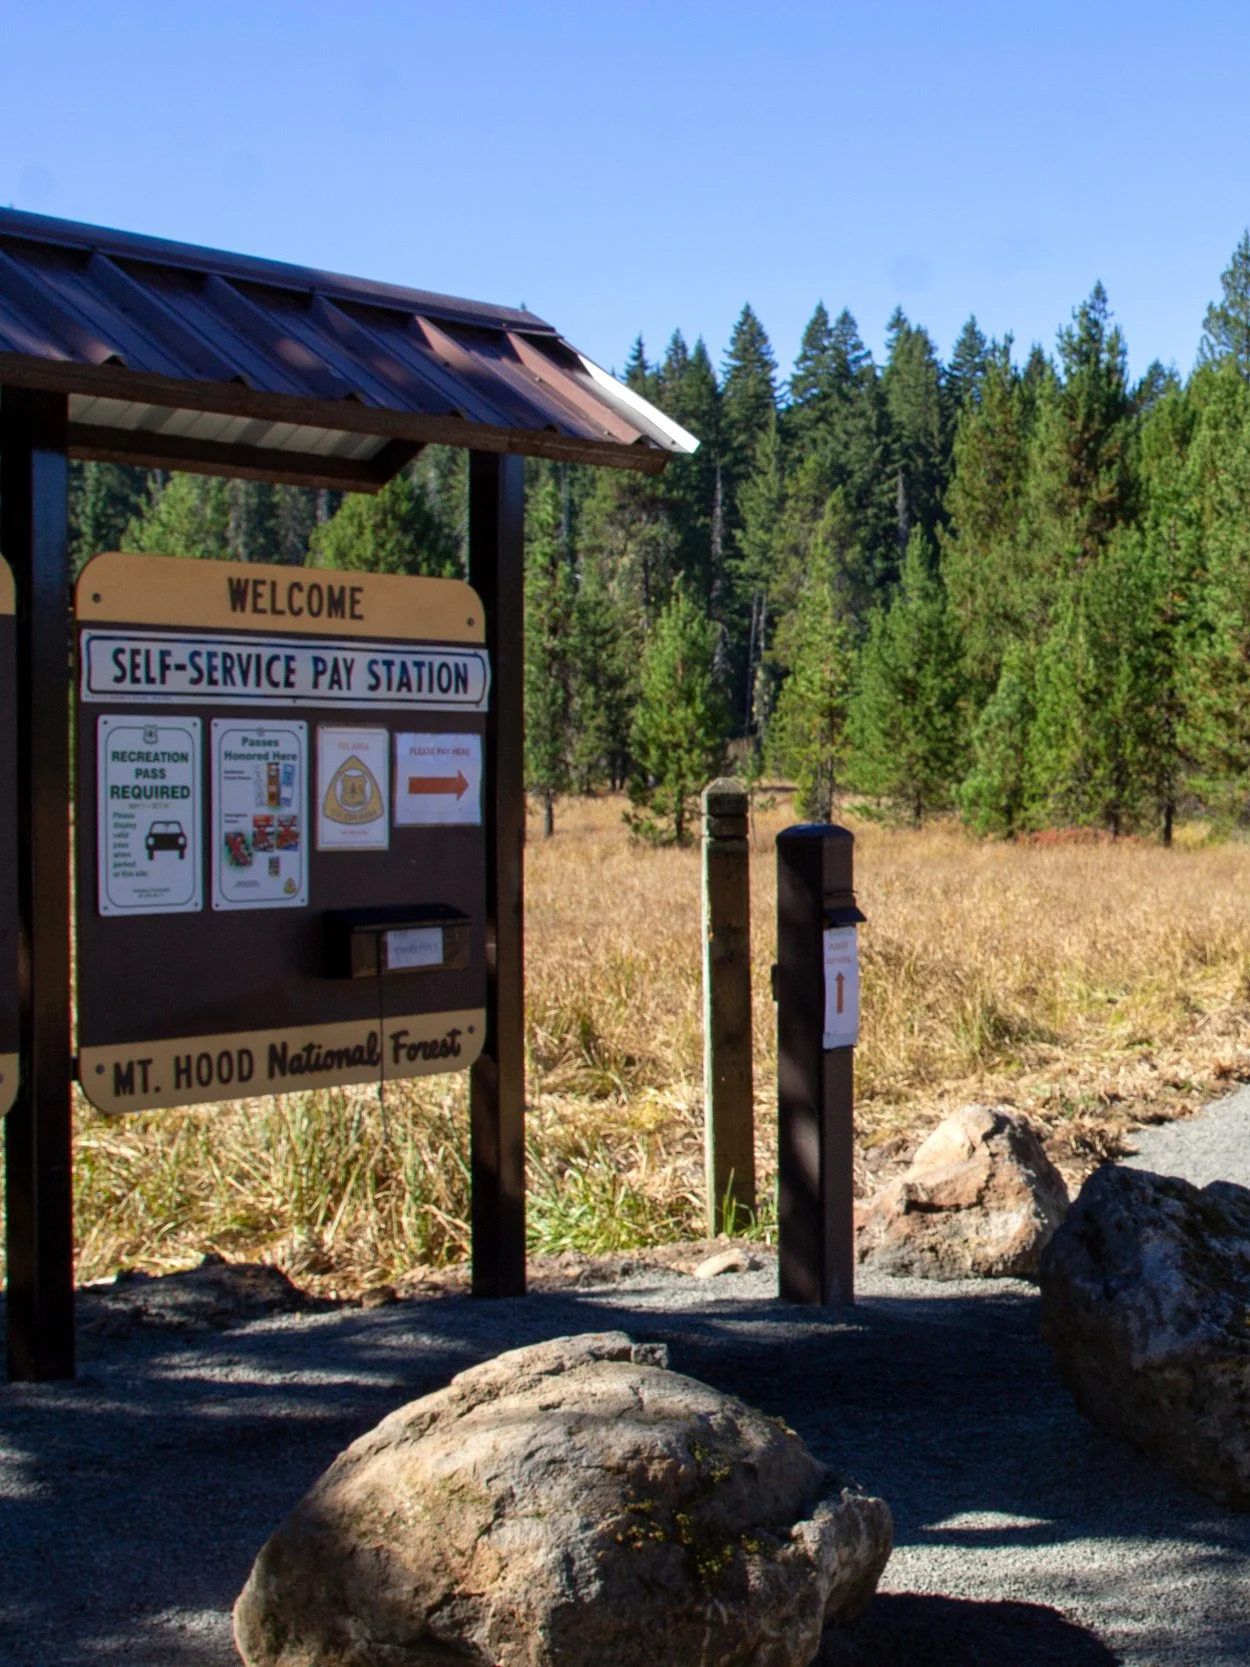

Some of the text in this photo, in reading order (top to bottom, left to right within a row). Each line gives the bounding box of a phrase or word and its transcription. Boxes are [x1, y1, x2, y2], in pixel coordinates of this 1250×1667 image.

[228, 577, 364, 621] WELCOME
[112, 646, 469, 695] SELF-SERVICE PAY STATION
[241, 736, 280, 747] Passes
[111, 751, 189, 763] RECREATION
[224, 750, 298, 761] Honored Here
[409, 747, 435, 756] PLEASE
[452, 748, 470, 756] HERE
[135, 767, 167, 779] PASS
[110, 785, 191, 799] REQUIRED
[112, 811, 135, 819] Please
[112, 822, 137, 830] display
[112, 861, 136, 869] parked
[113, 1028, 463, 1097] MT. HOOD National Forest
